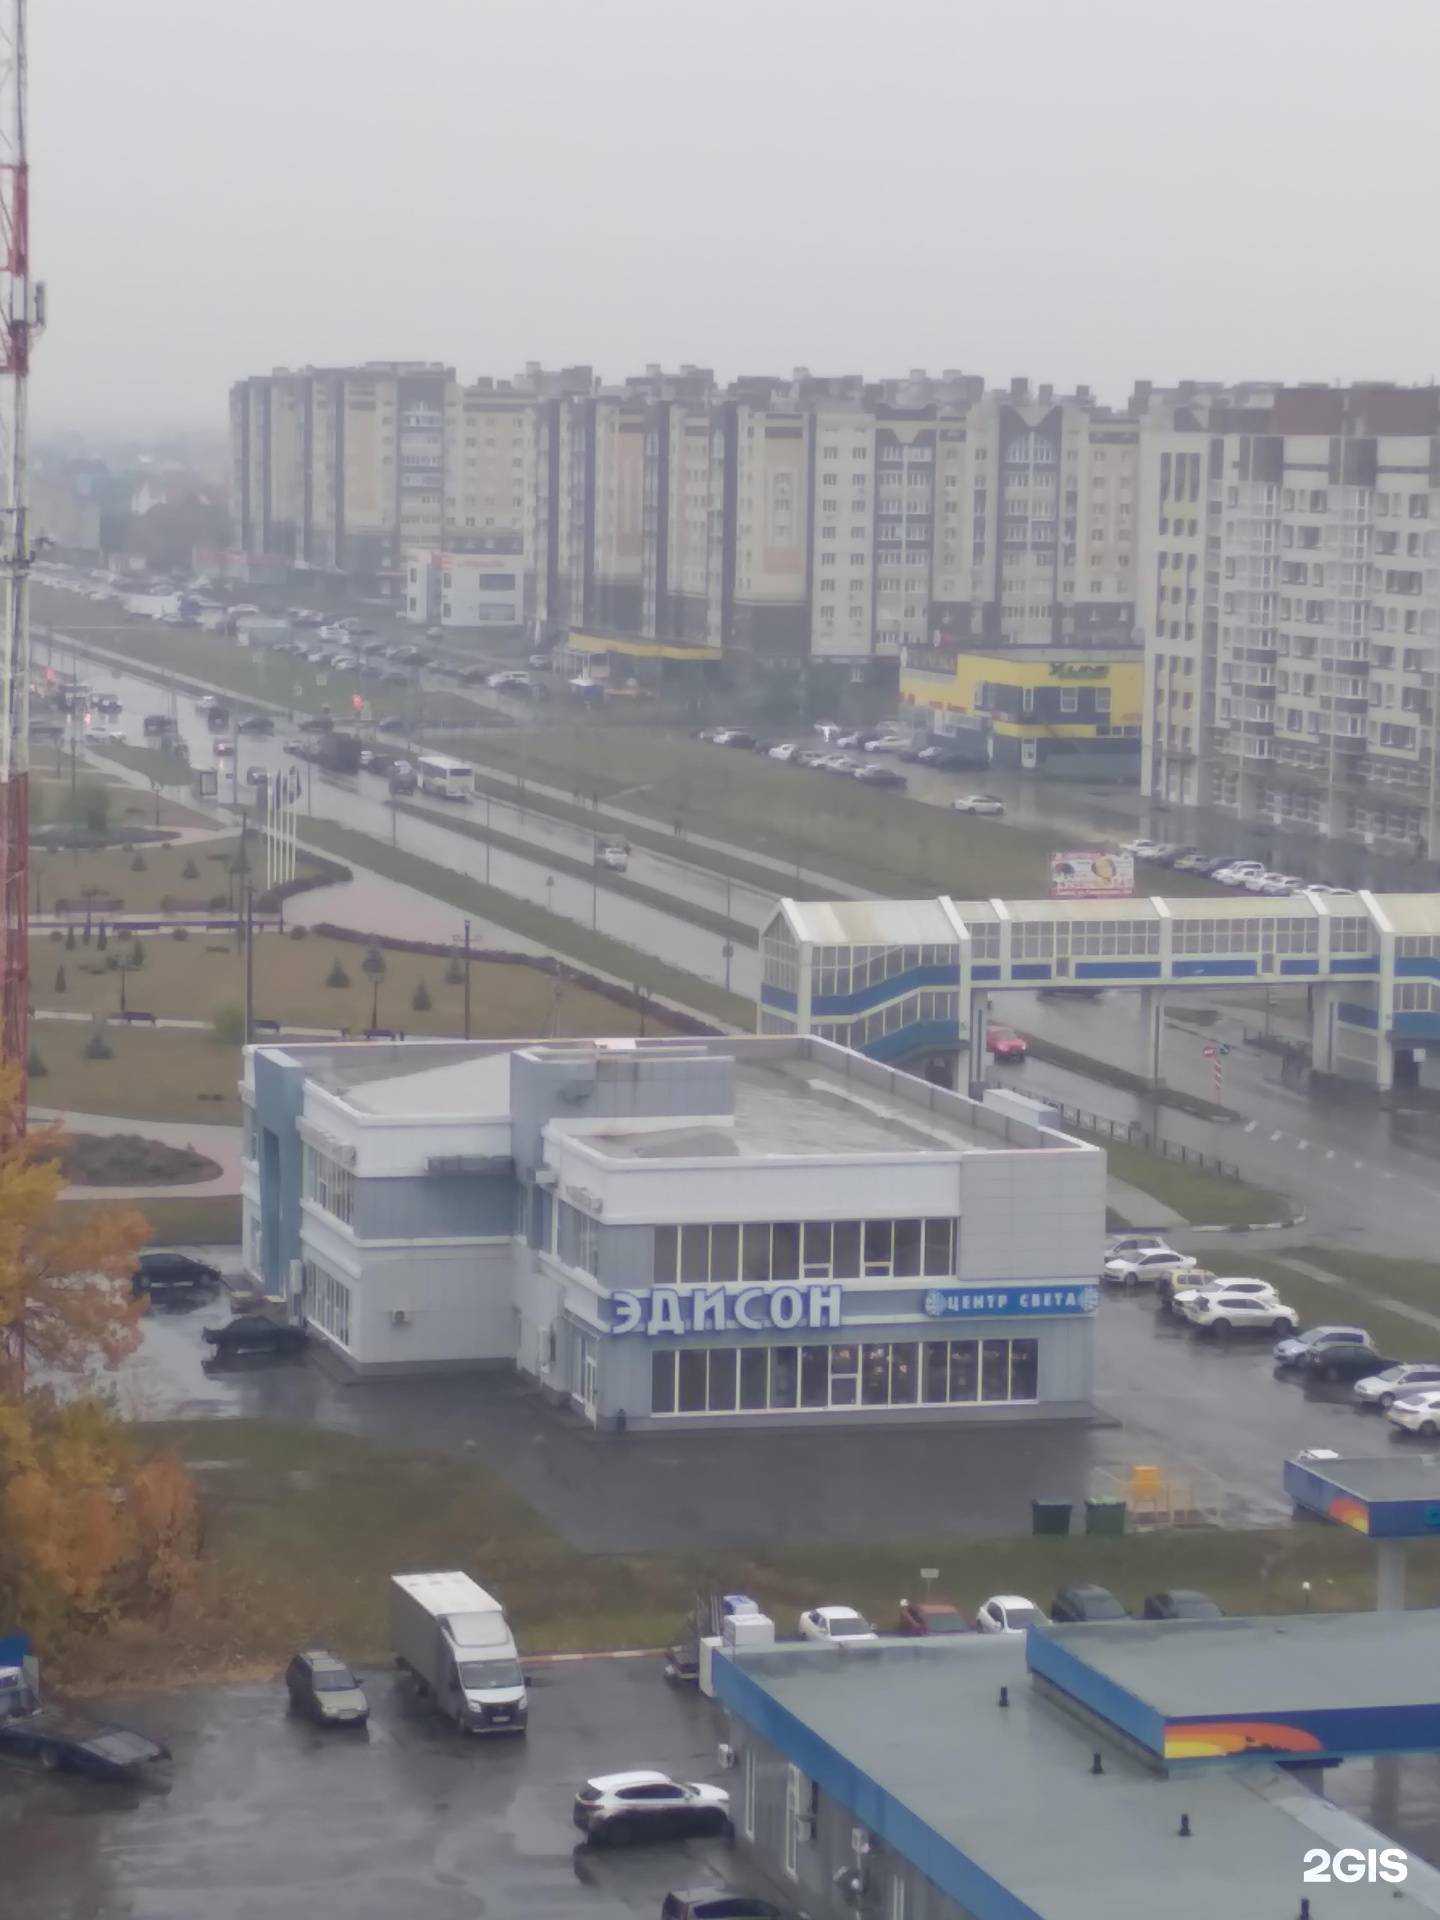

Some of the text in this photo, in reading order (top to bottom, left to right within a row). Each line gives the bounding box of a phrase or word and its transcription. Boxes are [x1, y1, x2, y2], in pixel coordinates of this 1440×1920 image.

[611, 1285, 842, 1335] ЭДИСОН
[948, 1292, 1077, 1311] ЦЕНТР СВЕТА
